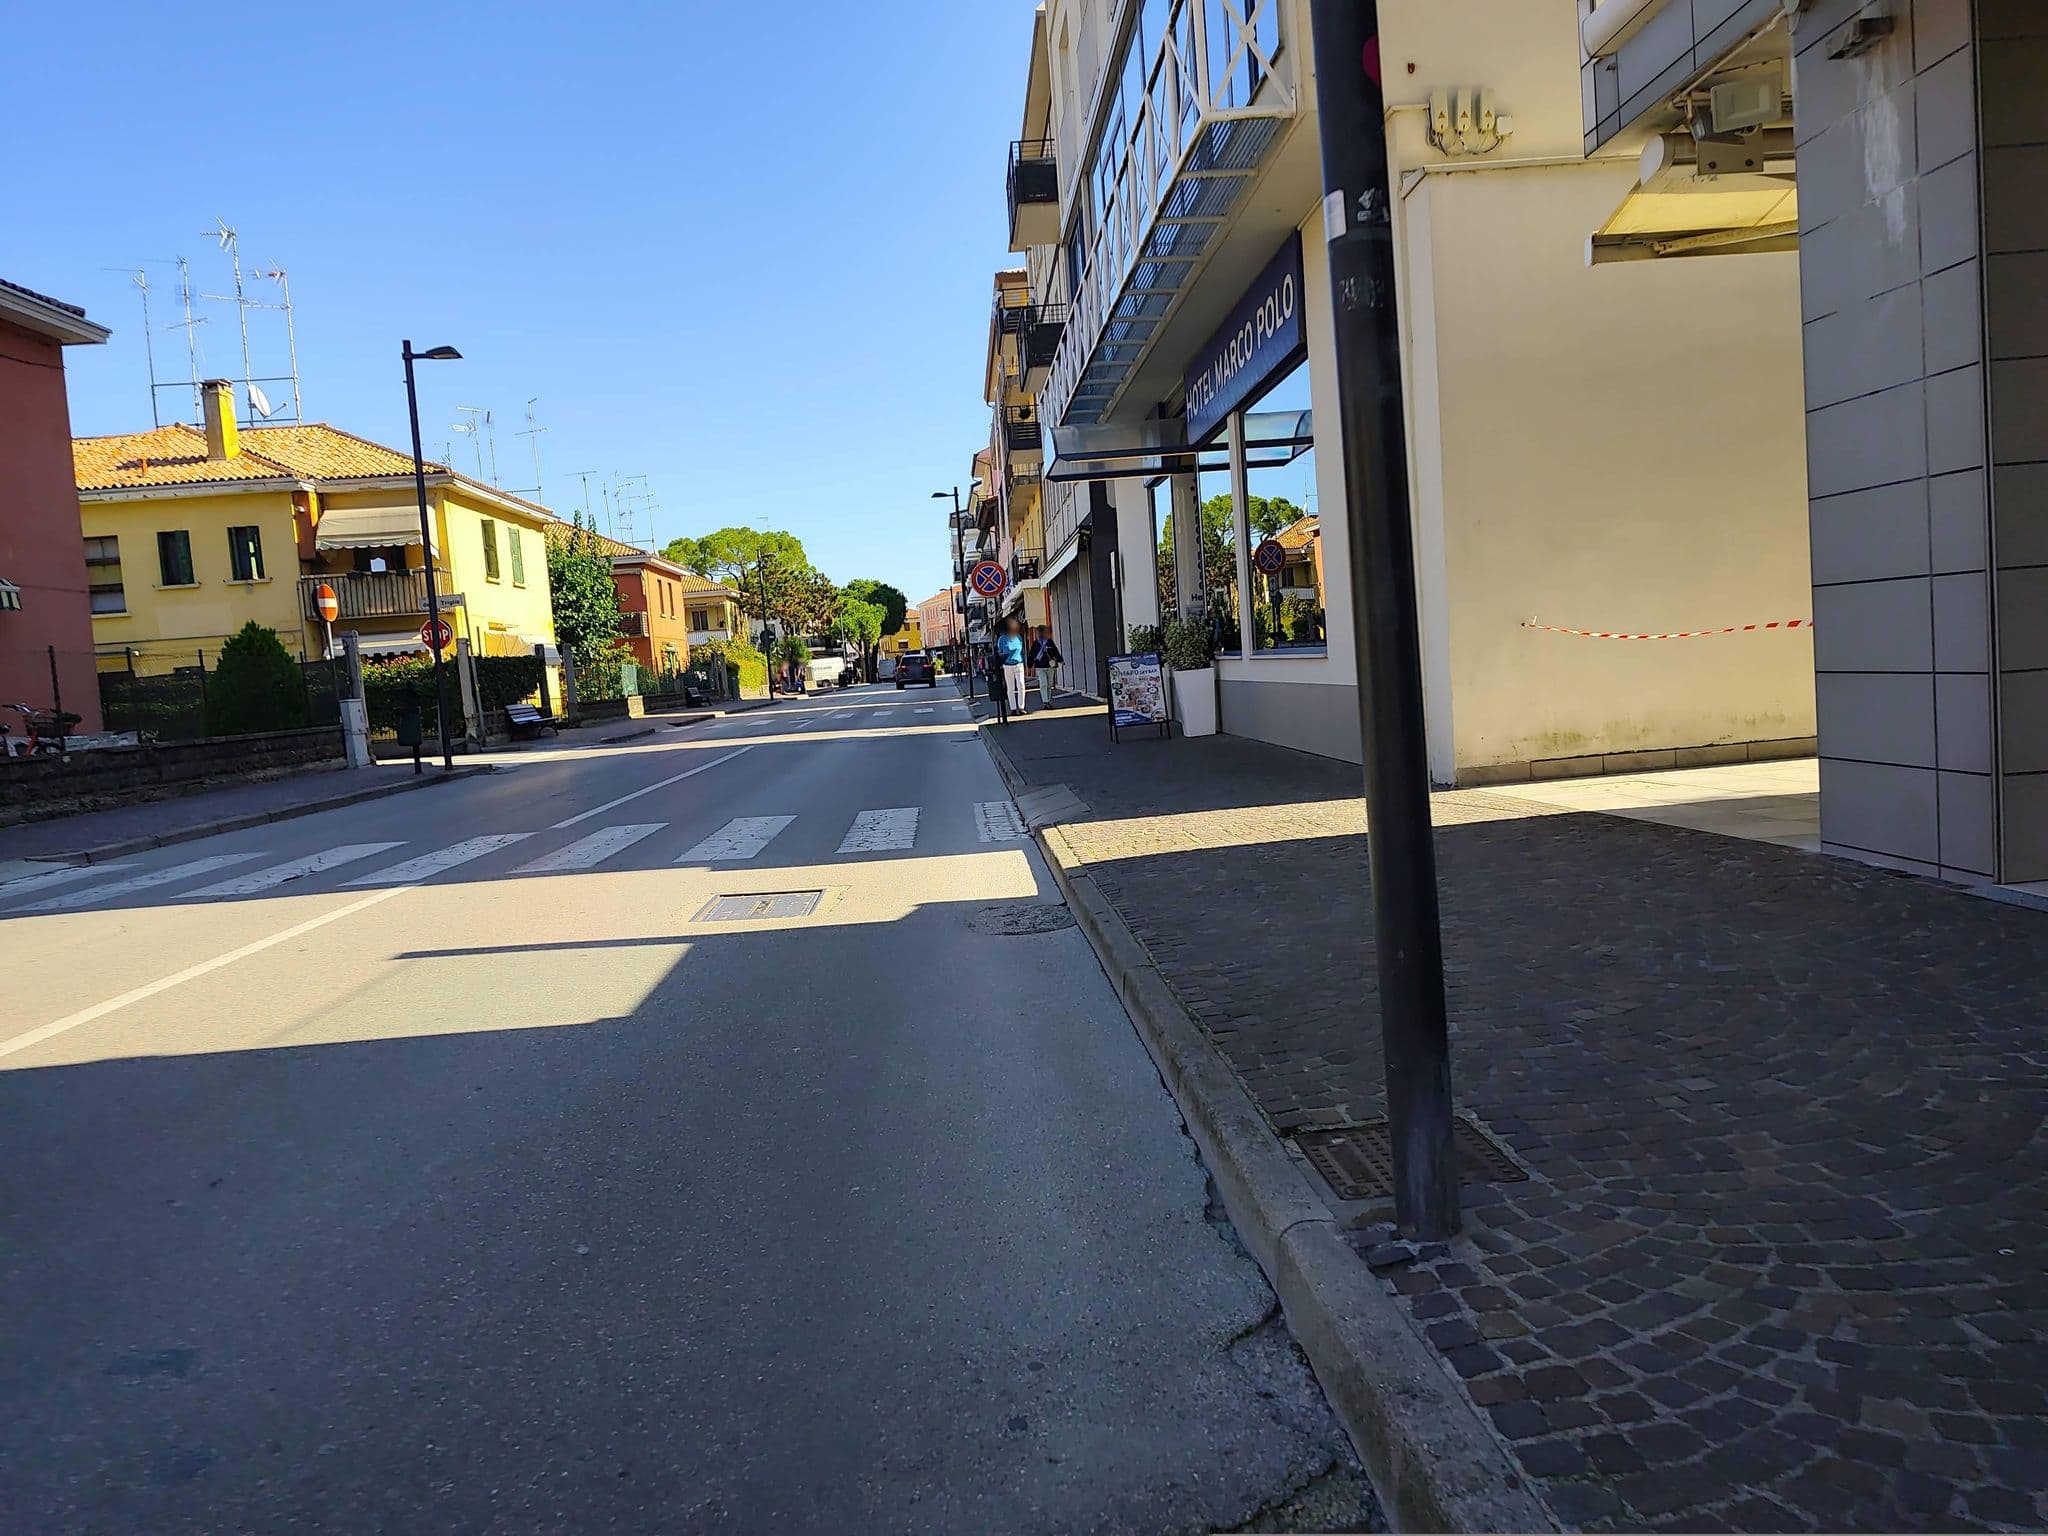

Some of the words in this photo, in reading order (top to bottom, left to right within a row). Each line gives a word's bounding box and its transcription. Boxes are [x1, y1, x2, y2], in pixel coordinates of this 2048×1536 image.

[1186, 368, 1214, 423] HOTEL
[1214, 321, 1253, 393] MARCO
[1256, 273, 1294, 350] POLO
[423, 629, 449, 642] STP
